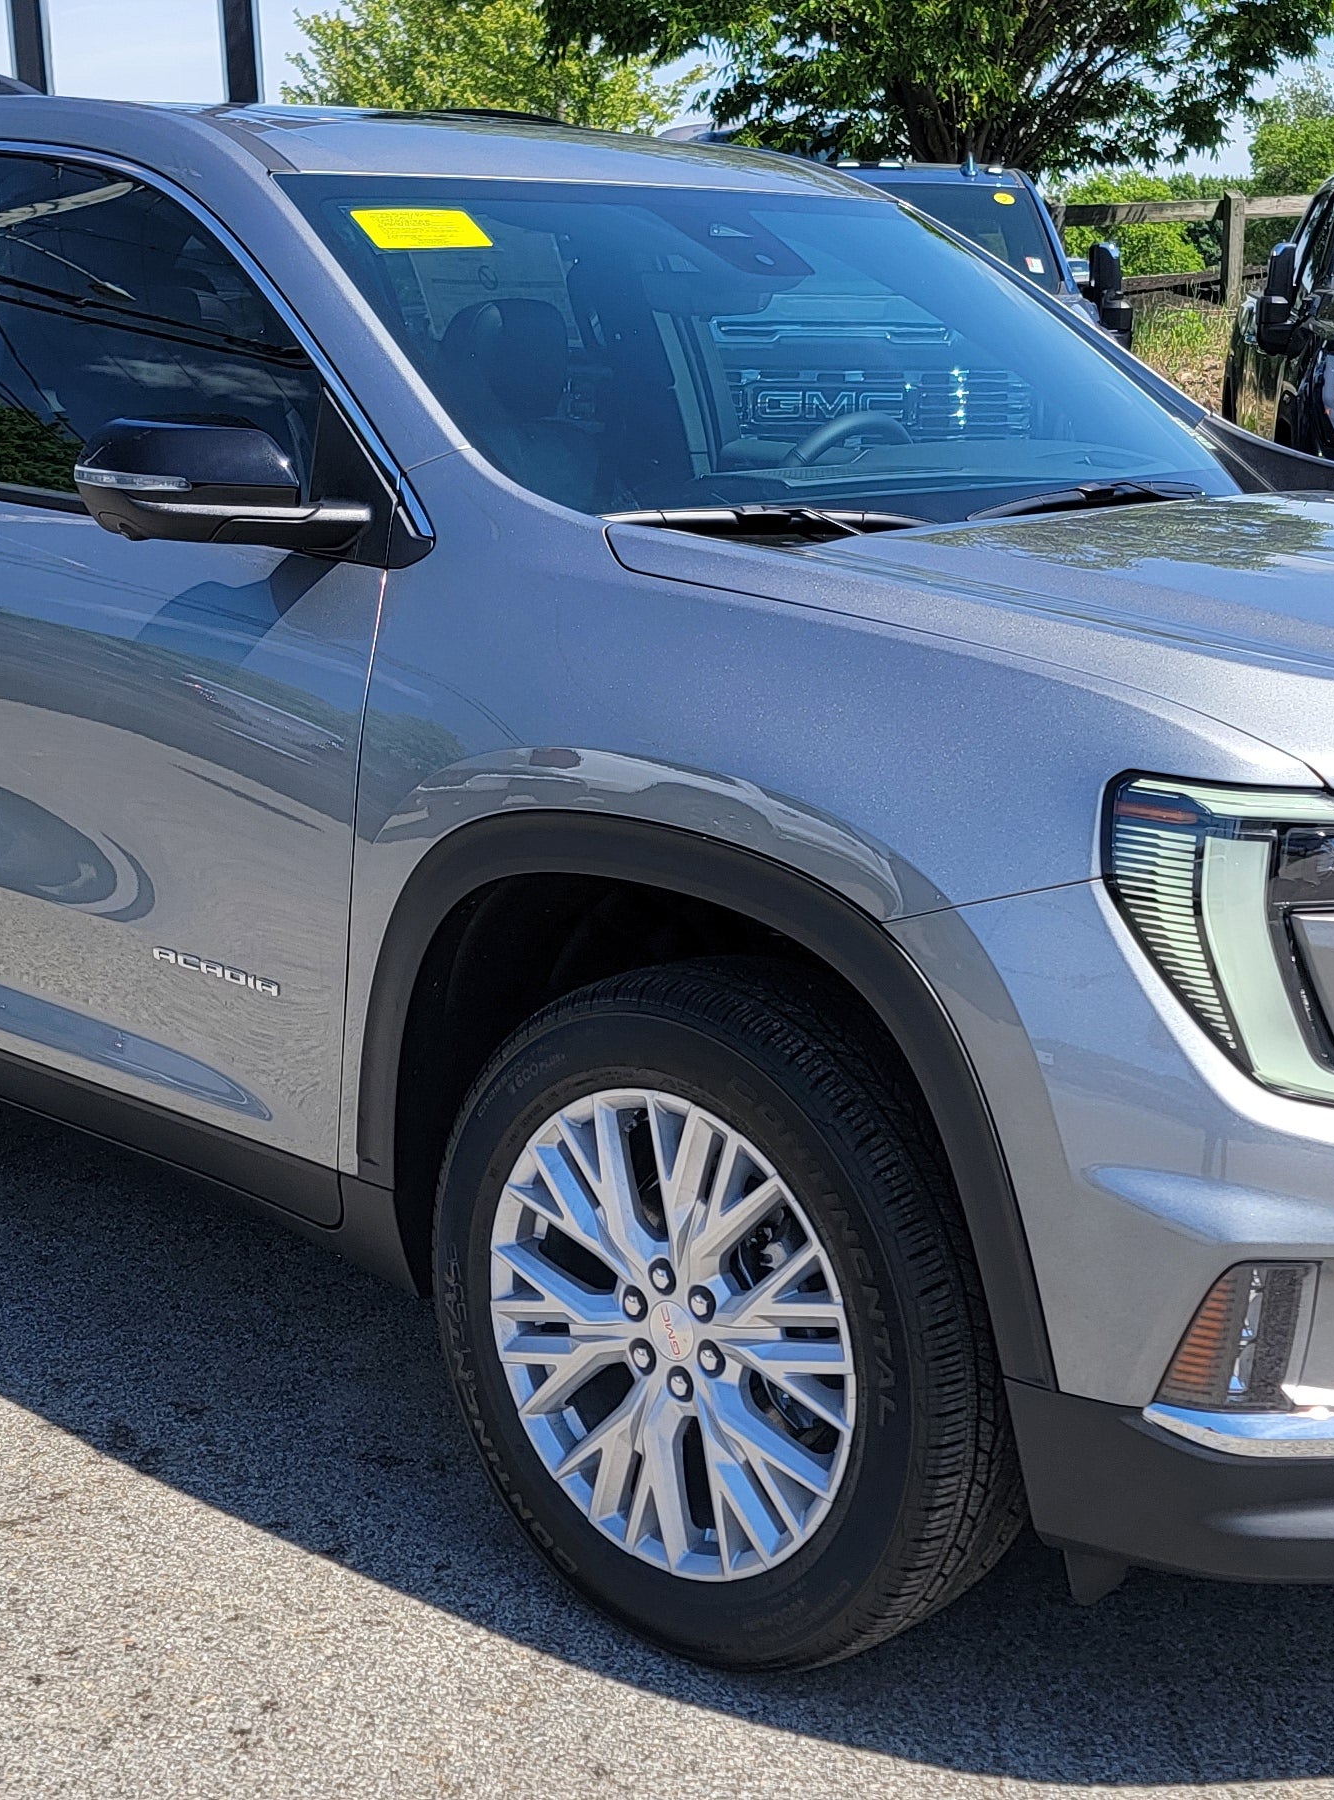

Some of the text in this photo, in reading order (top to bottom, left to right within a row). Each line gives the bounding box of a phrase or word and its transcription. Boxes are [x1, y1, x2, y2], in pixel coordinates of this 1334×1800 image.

[757, 391, 904, 419] GMC
[152, 946, 281, 997] ACADIA
[726, 1073, 896, 1427] CONTINENTAL
[660, 1305, 681, 1356] GMC
